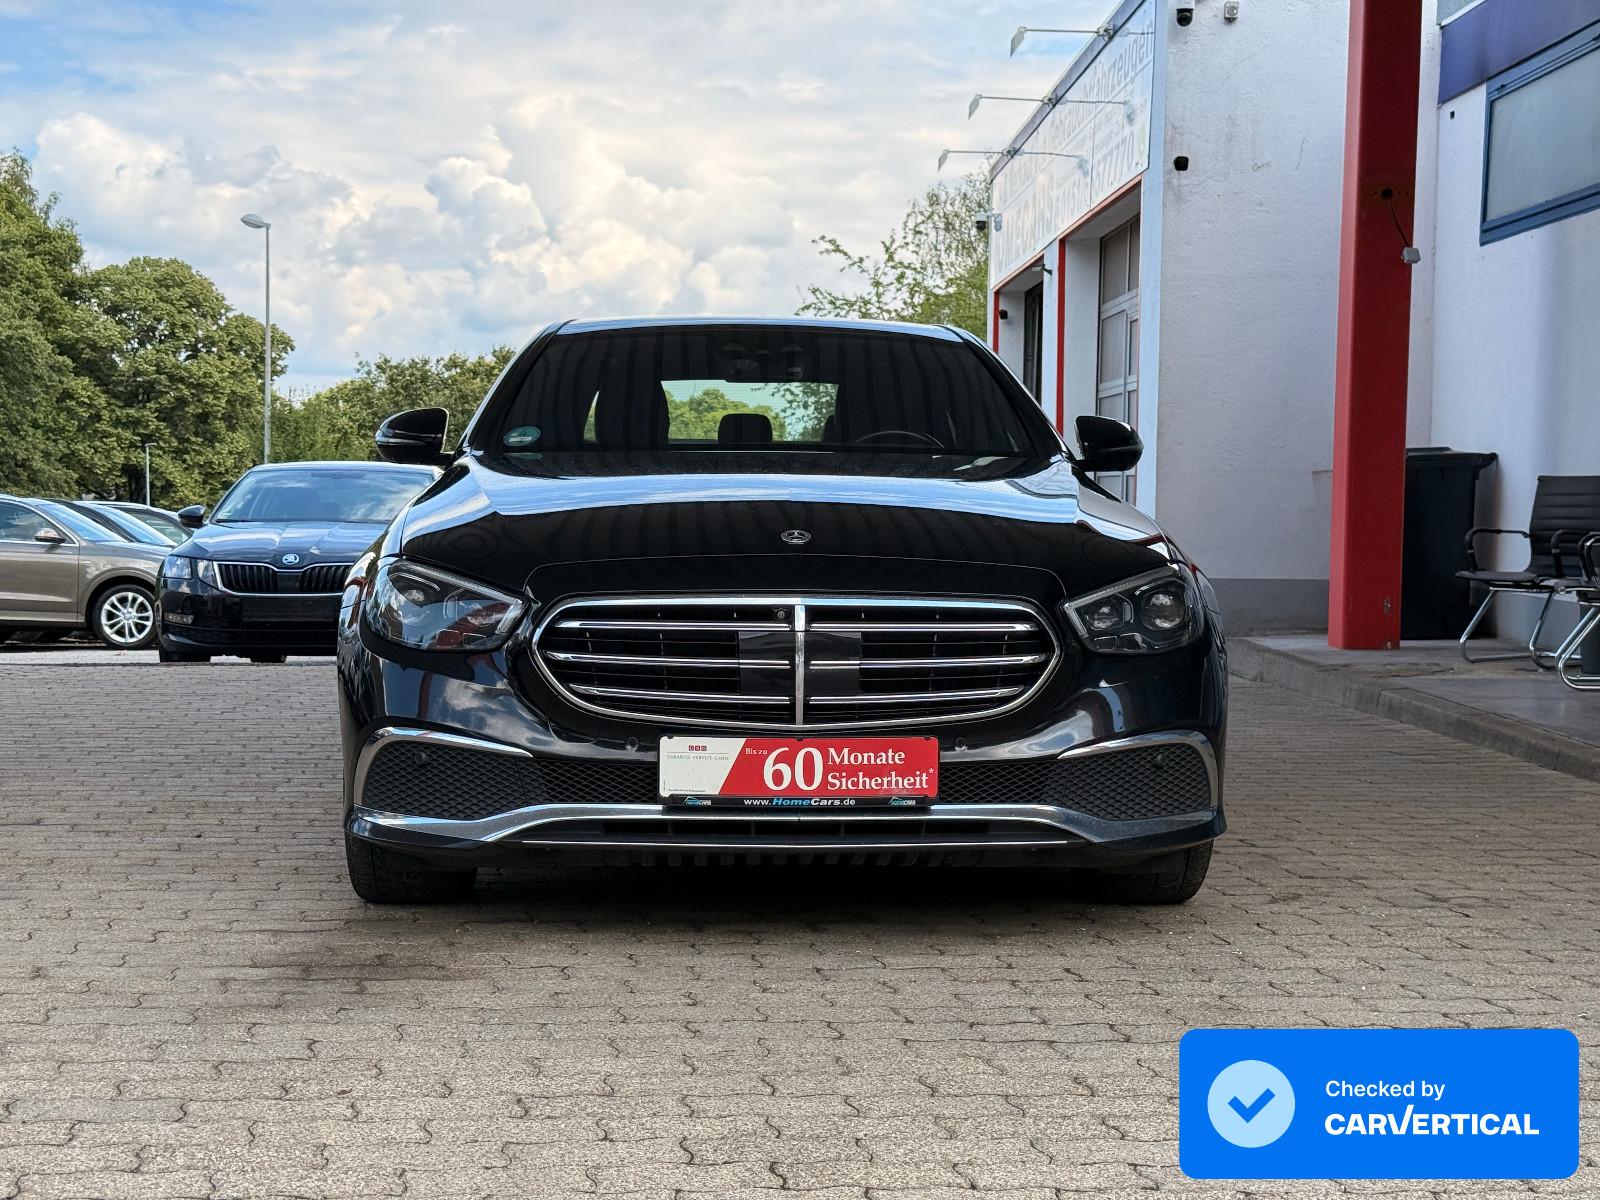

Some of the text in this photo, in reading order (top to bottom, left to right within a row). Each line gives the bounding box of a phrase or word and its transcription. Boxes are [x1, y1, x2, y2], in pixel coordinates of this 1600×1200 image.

[827, 748, 905, 765] Monate
[763, 747, 824, 791] 60
[743, 797, 856, 806] www.HomeCars.de
